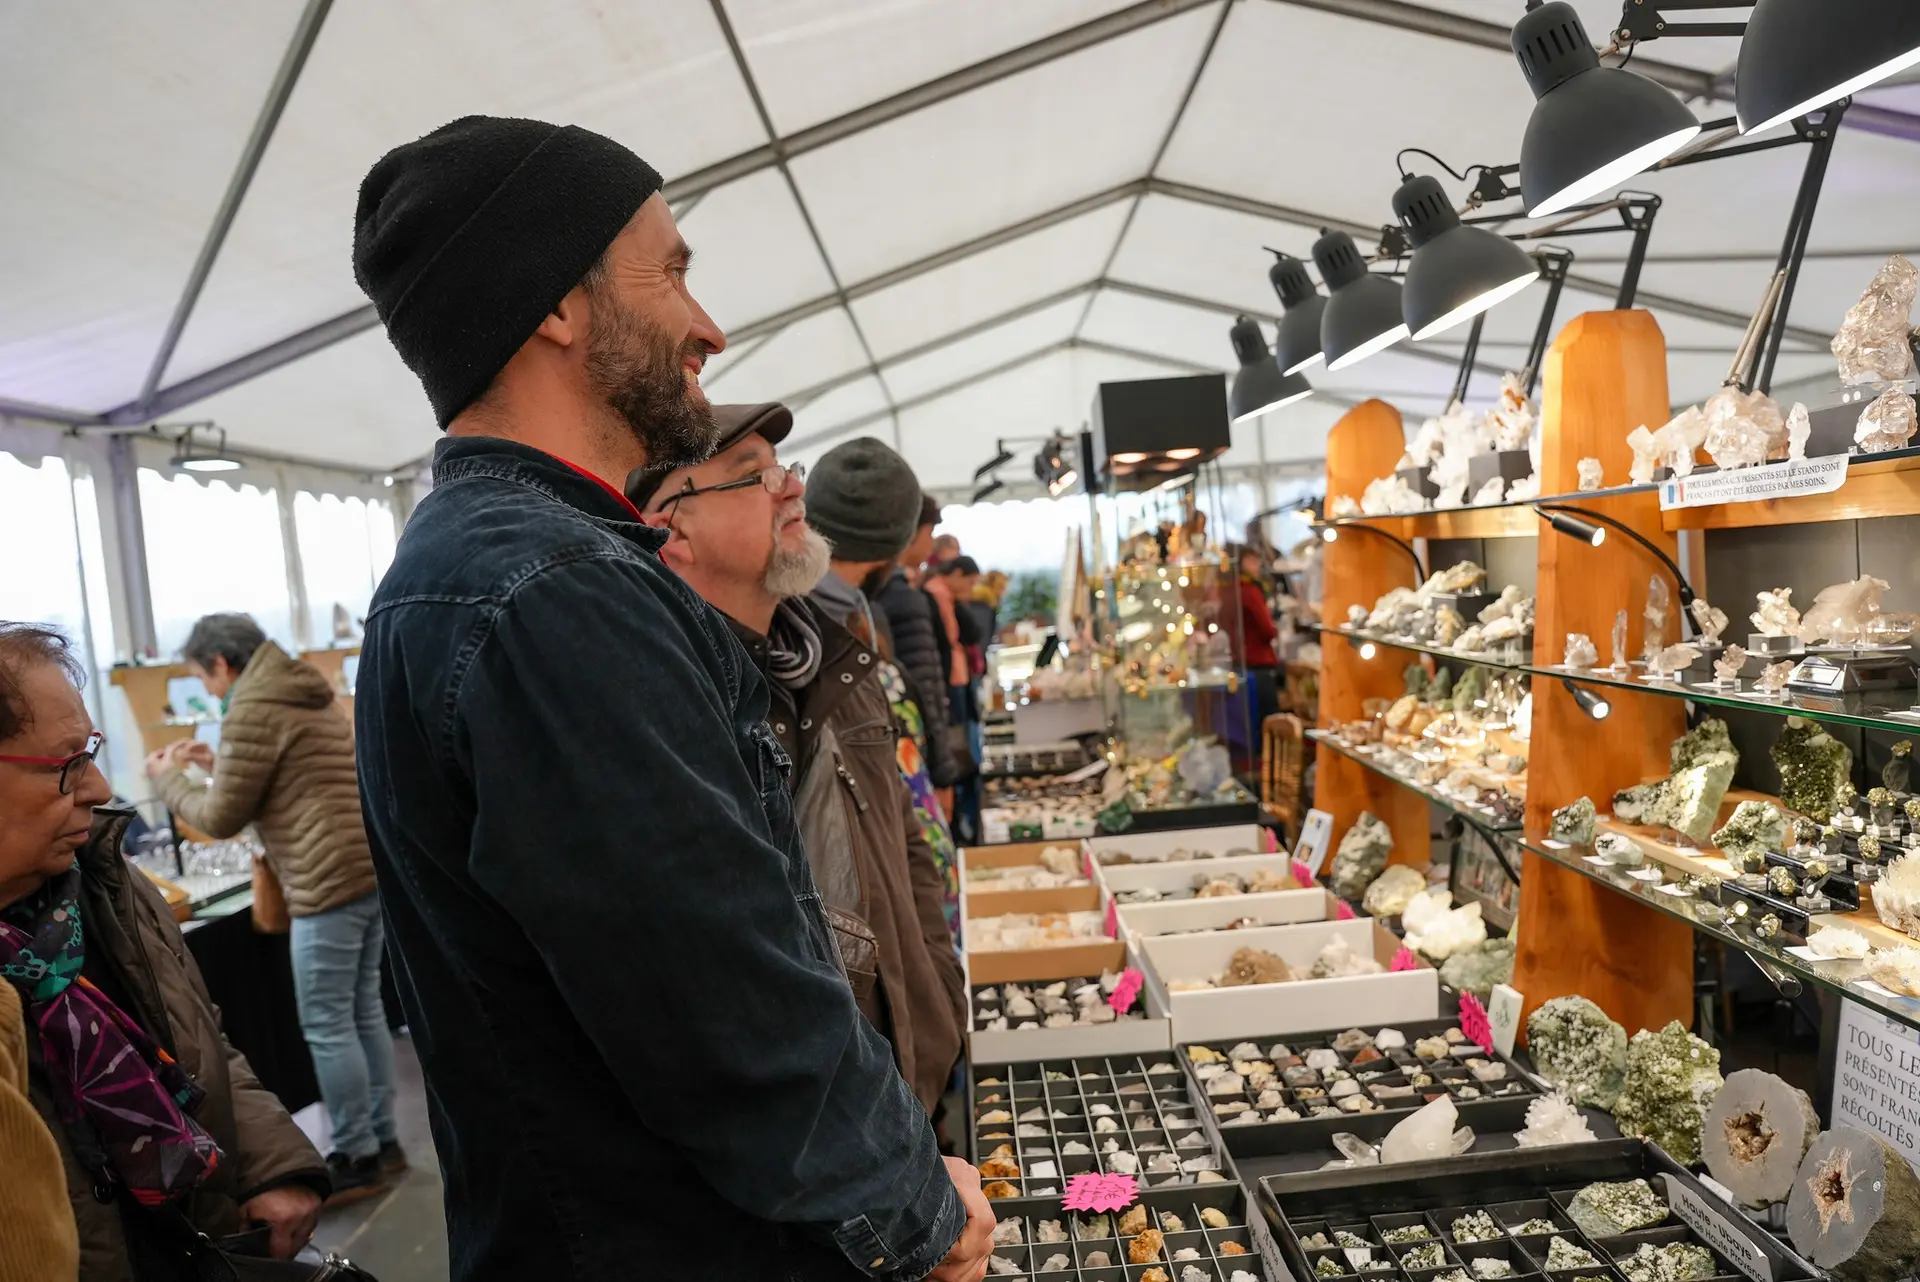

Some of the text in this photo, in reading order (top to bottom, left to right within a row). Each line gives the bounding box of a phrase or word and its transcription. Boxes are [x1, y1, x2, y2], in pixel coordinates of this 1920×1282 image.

[1701, 480, 1711, 488] LES
[1742, 470, 1775, 483] PRÉSENTÉS
[1776, 470, 1788, 480] SUR
[1788, 468, 1797, 477] LE
[1798, 464, 1821, 476] STAND
[1821, 461, 1840, 473] SONT
[1733, 485, 1745, 496] ÉTÉ
[1746, 481, 1776, 494] RÉCOLTÉS
[1777, 481, 1789, 491] PAR
[1790, 478, 1804, 489] MES
[1805, 476, 1828, 488] SOINS.
[1847, 1023, 1893, 1063] TOUS
[1842, 1072, 1920, 1127] SONT FRAN
[1845, 1050, 1920, 1104] PRÉSENTÉ
[1841, 1093, 1914, 1149] RÉCOLTÉS
[1681, 1194, 1711, 1226] Haute
[1718, 1224, 1752, 1260] Ubaye
[1694, 1221, 1704, 1233] de
[1705, 1229, 1728, 1254] Haute
